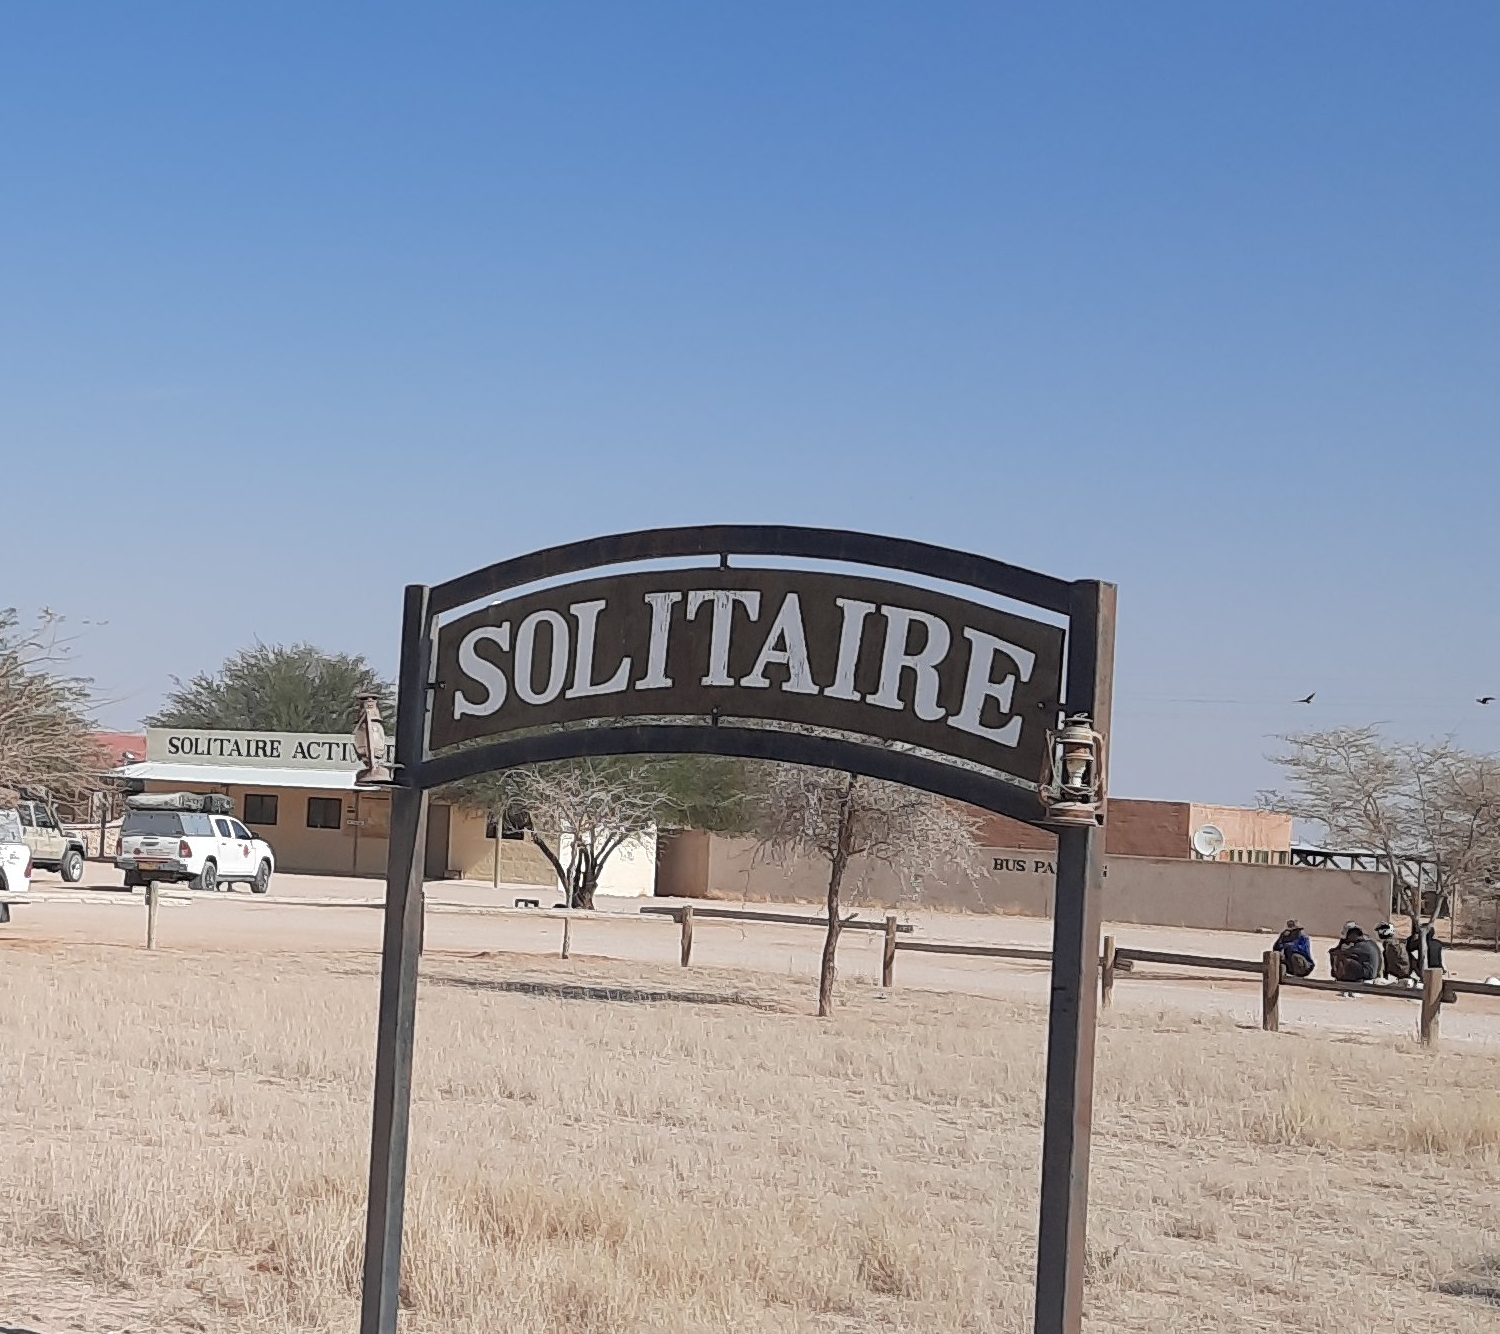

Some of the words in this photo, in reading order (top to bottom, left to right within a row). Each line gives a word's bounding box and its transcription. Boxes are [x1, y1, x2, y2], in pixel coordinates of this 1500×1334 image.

[453, 589, 1036, 749] SOLITAIRE
[168, 736, 282, 759] SOLITAIRE
[992, 857, 1026, 872] BUS
